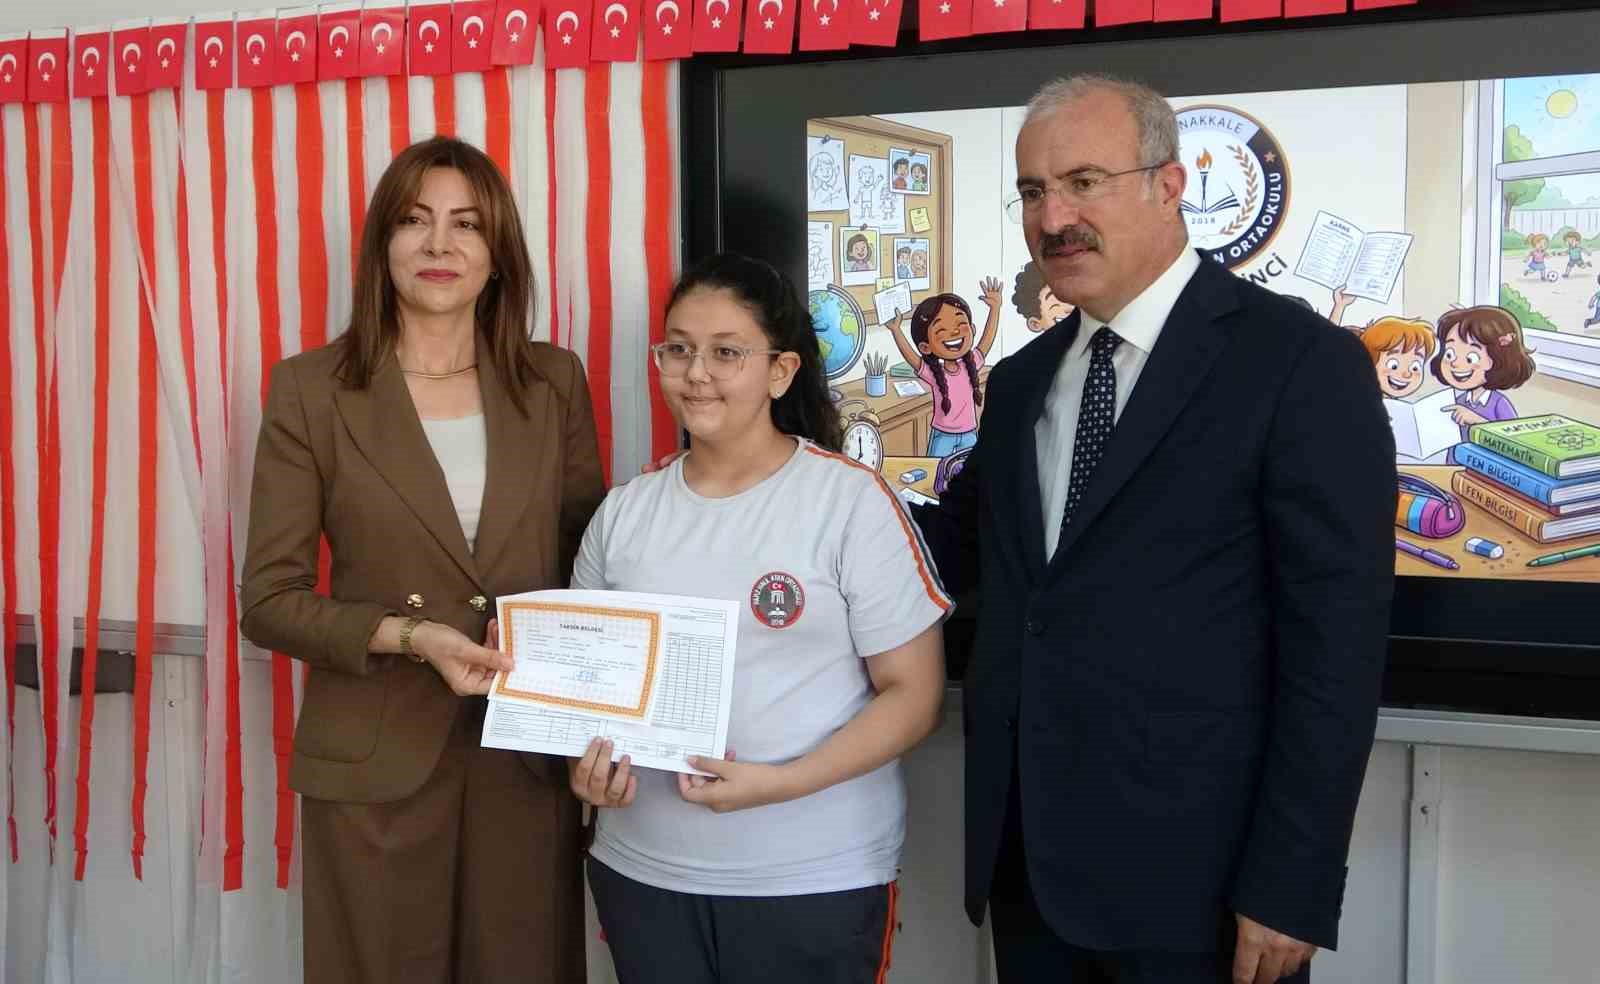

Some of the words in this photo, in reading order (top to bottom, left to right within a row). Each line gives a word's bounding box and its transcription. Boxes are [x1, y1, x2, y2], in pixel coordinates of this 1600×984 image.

[1180, 115, 1243, 135] NAKKALE
[1230, 172, 1282, 258] ORTAOKULU
[1466, 454, 1485, 471] FEN
[1466, 486, 1483, 503] FEN
